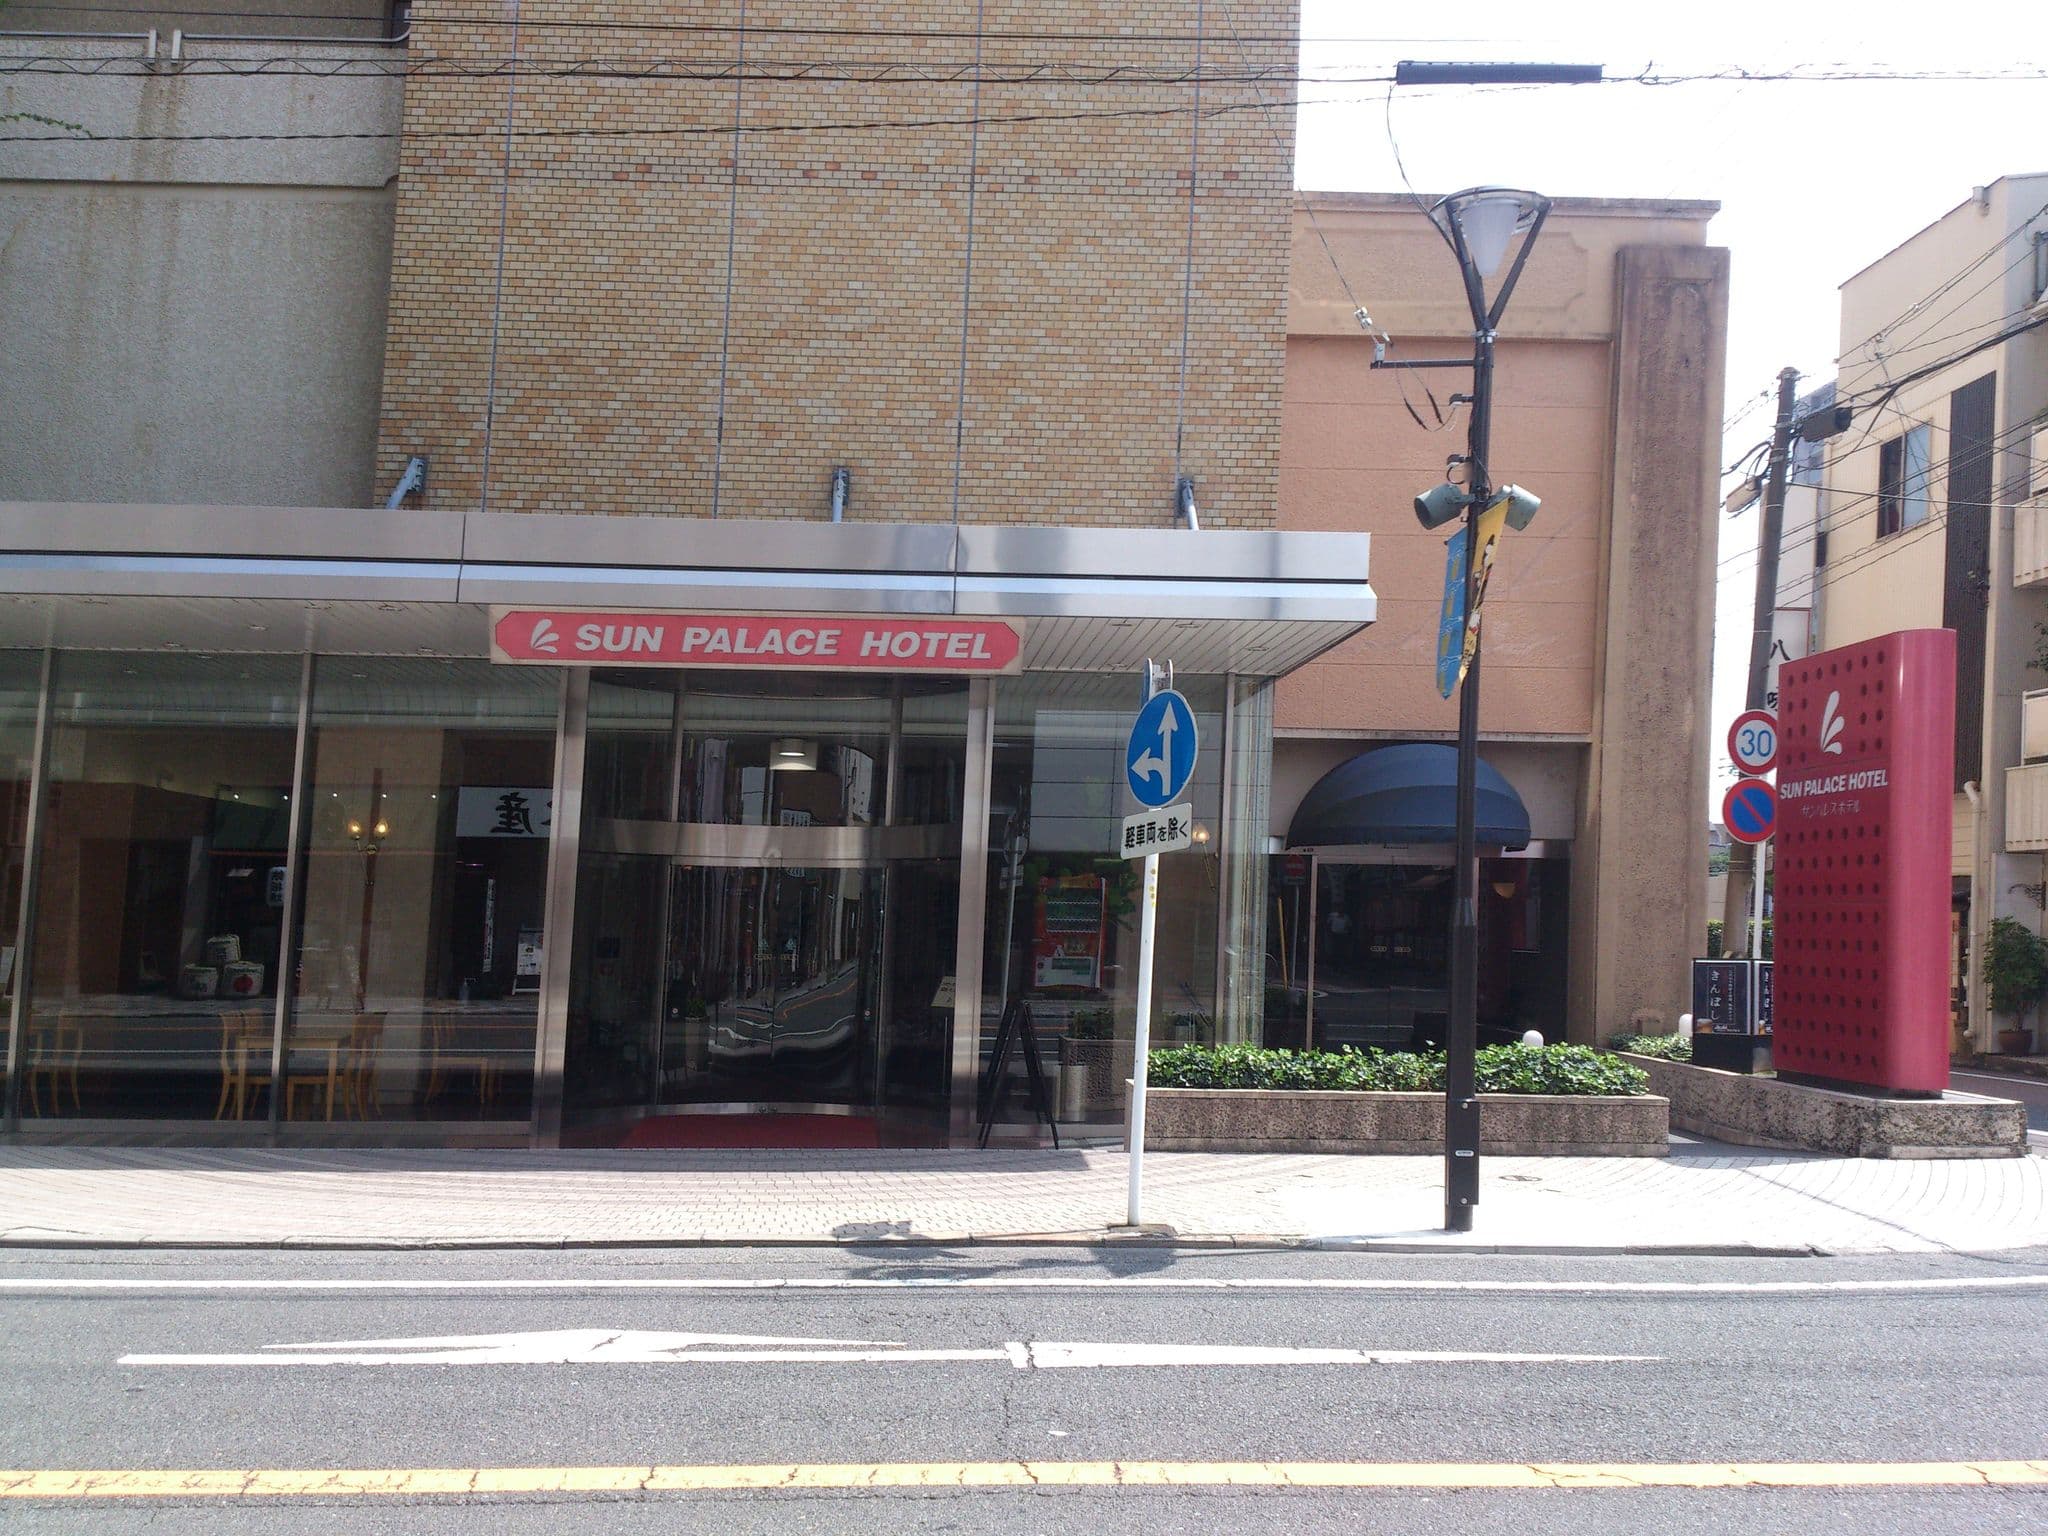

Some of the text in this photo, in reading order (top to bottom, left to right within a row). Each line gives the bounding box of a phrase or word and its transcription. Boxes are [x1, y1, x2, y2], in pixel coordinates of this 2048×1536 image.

[575, 623, 991, 660] SUN PALACE HOTEL
[1741, 729, 1772, 757] 30
[1779, 769, 1888, 800] SUN PALACE HOTEL
[1124, 817, 1188, 849] 軽車両を除く
